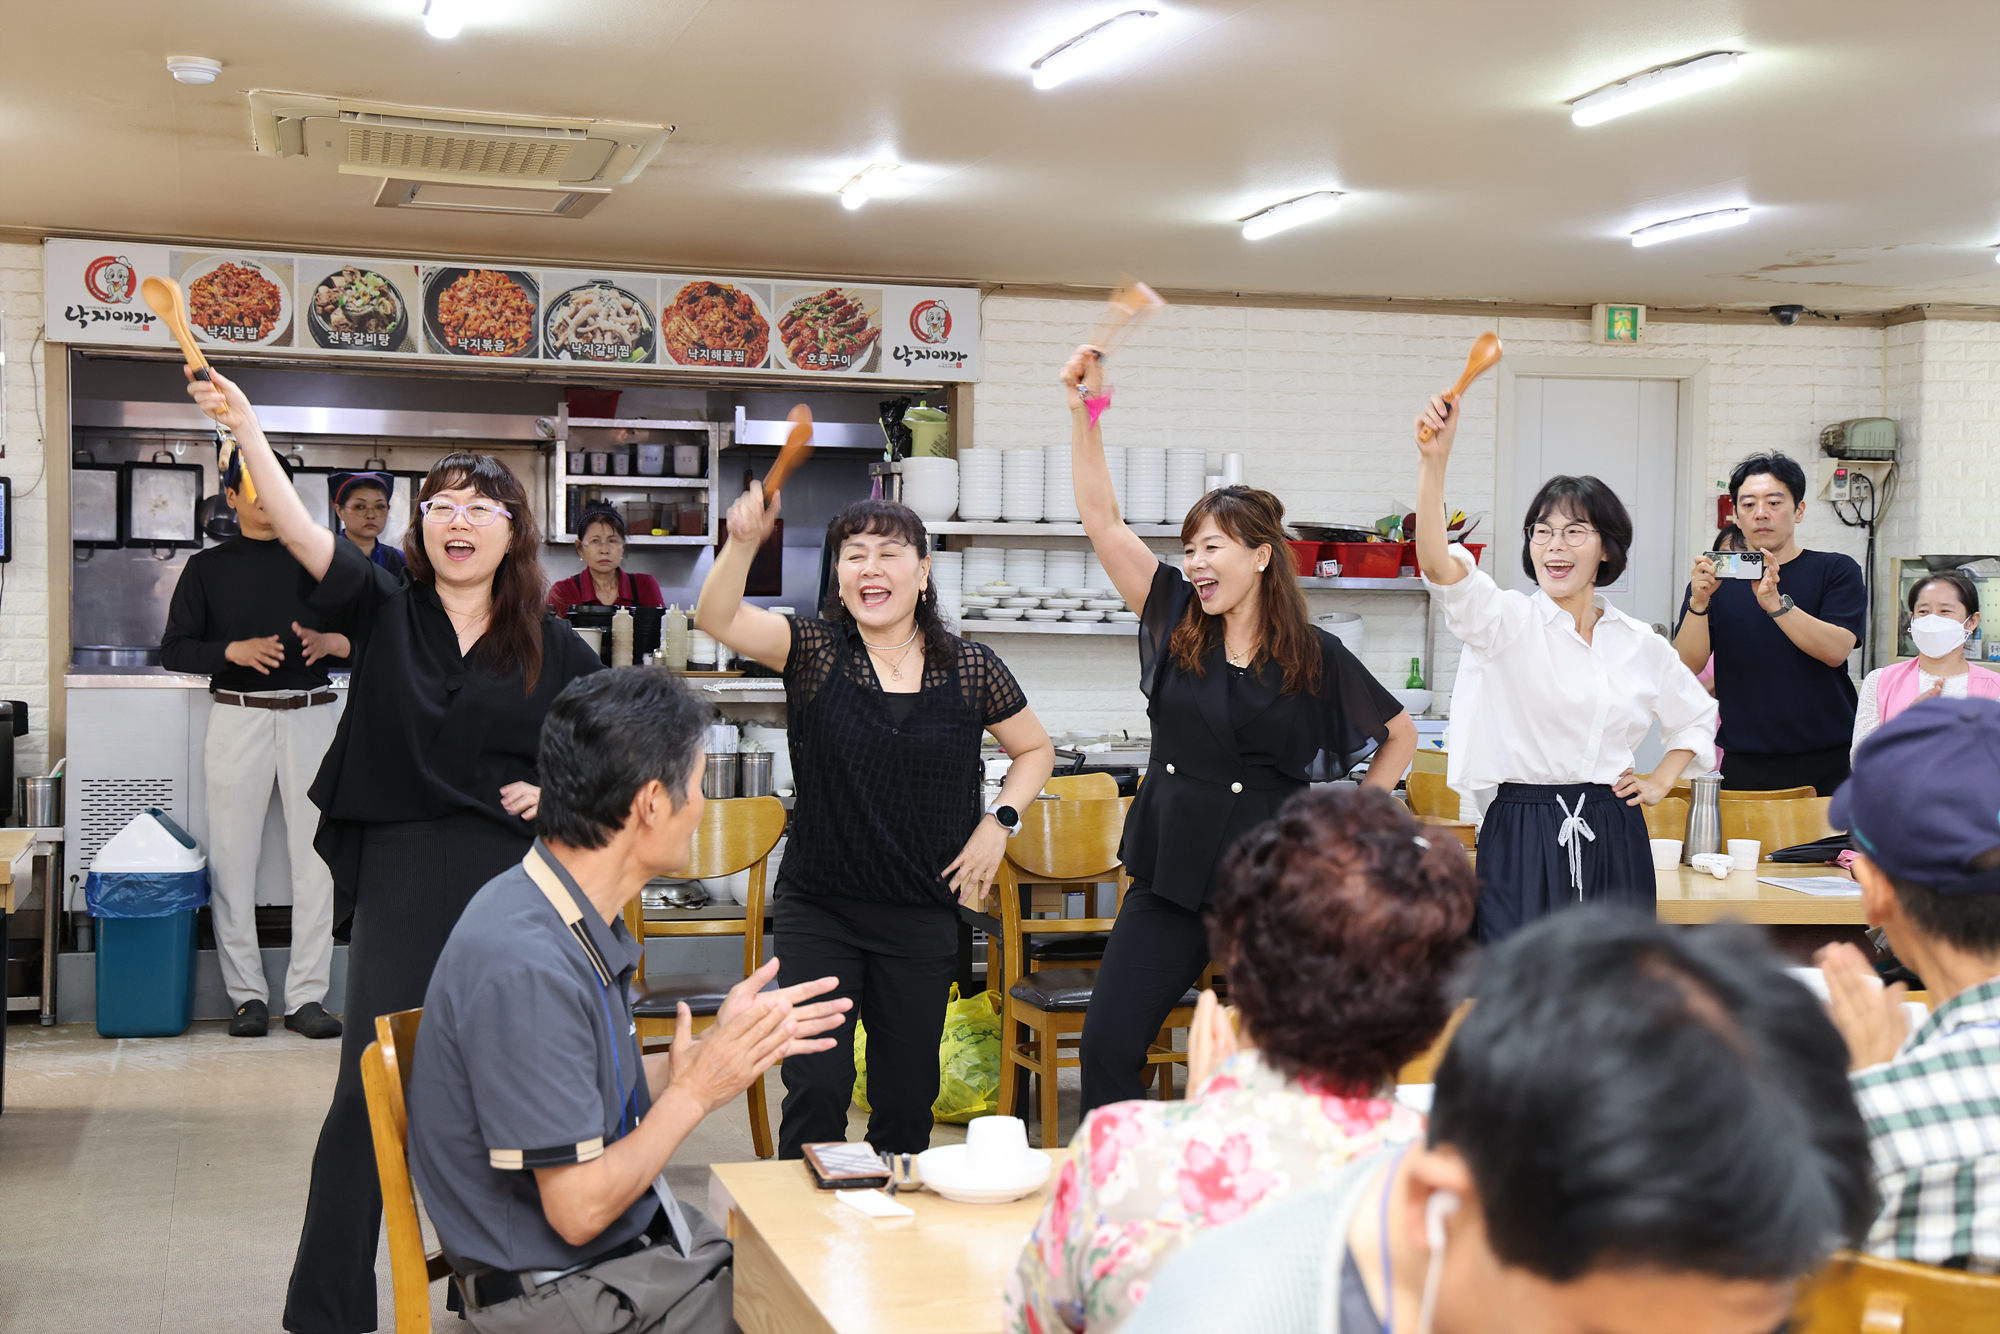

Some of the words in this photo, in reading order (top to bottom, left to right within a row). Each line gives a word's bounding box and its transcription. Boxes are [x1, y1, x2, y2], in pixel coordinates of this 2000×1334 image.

[65, 304, 157, 329] 낙지애가
[207, 325, 258, 340] 낙지덮밥
[327, 331, 391, 347] 전복갈비탕
[457, 337, 506, 352] 낙지볶음
[571, 342, 631, 357] 낙지갈비찜
[688, 348, 745, 362] 낙지해물찜
[806, 353, 852, 367] 호롱구이
[892, 345, 969, 368] 낙지애가
